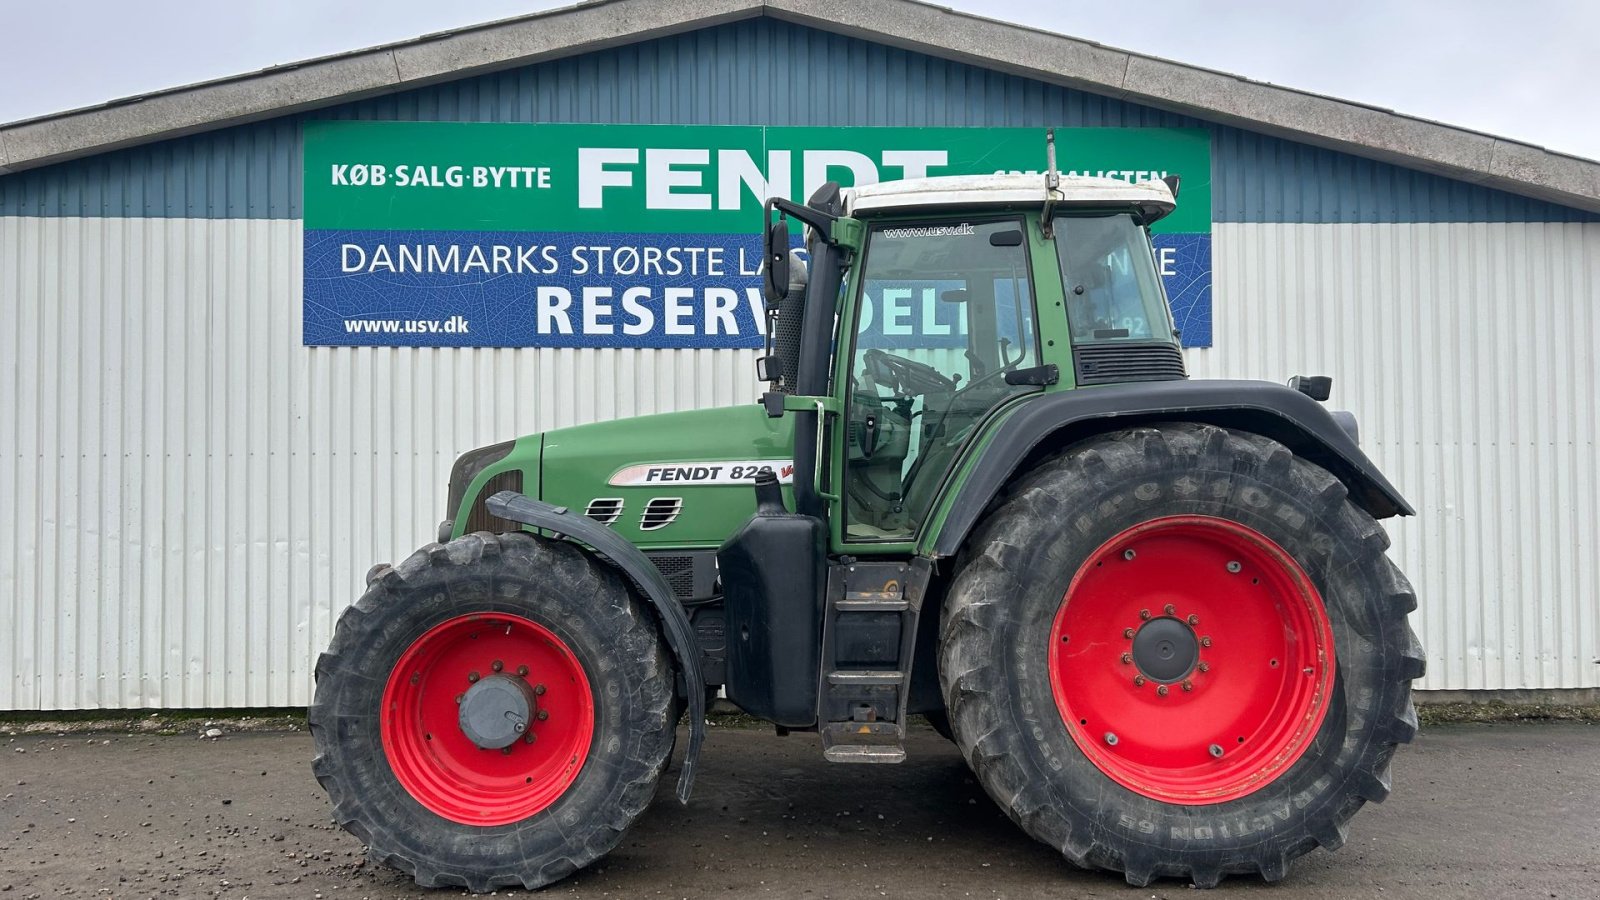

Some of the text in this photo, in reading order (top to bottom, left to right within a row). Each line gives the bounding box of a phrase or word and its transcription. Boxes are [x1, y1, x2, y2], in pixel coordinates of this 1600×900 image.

[578, 147, 949, 211] FENDT
[883, 222, 975, 239] www.usv.dk
[341, 244, 559, 275] DANMARKS
[572, 245, 725, 276] STØRSTE
[343, 315, 470, 333] www.usv.dk
[646, 466, 723, 482] FENDT
